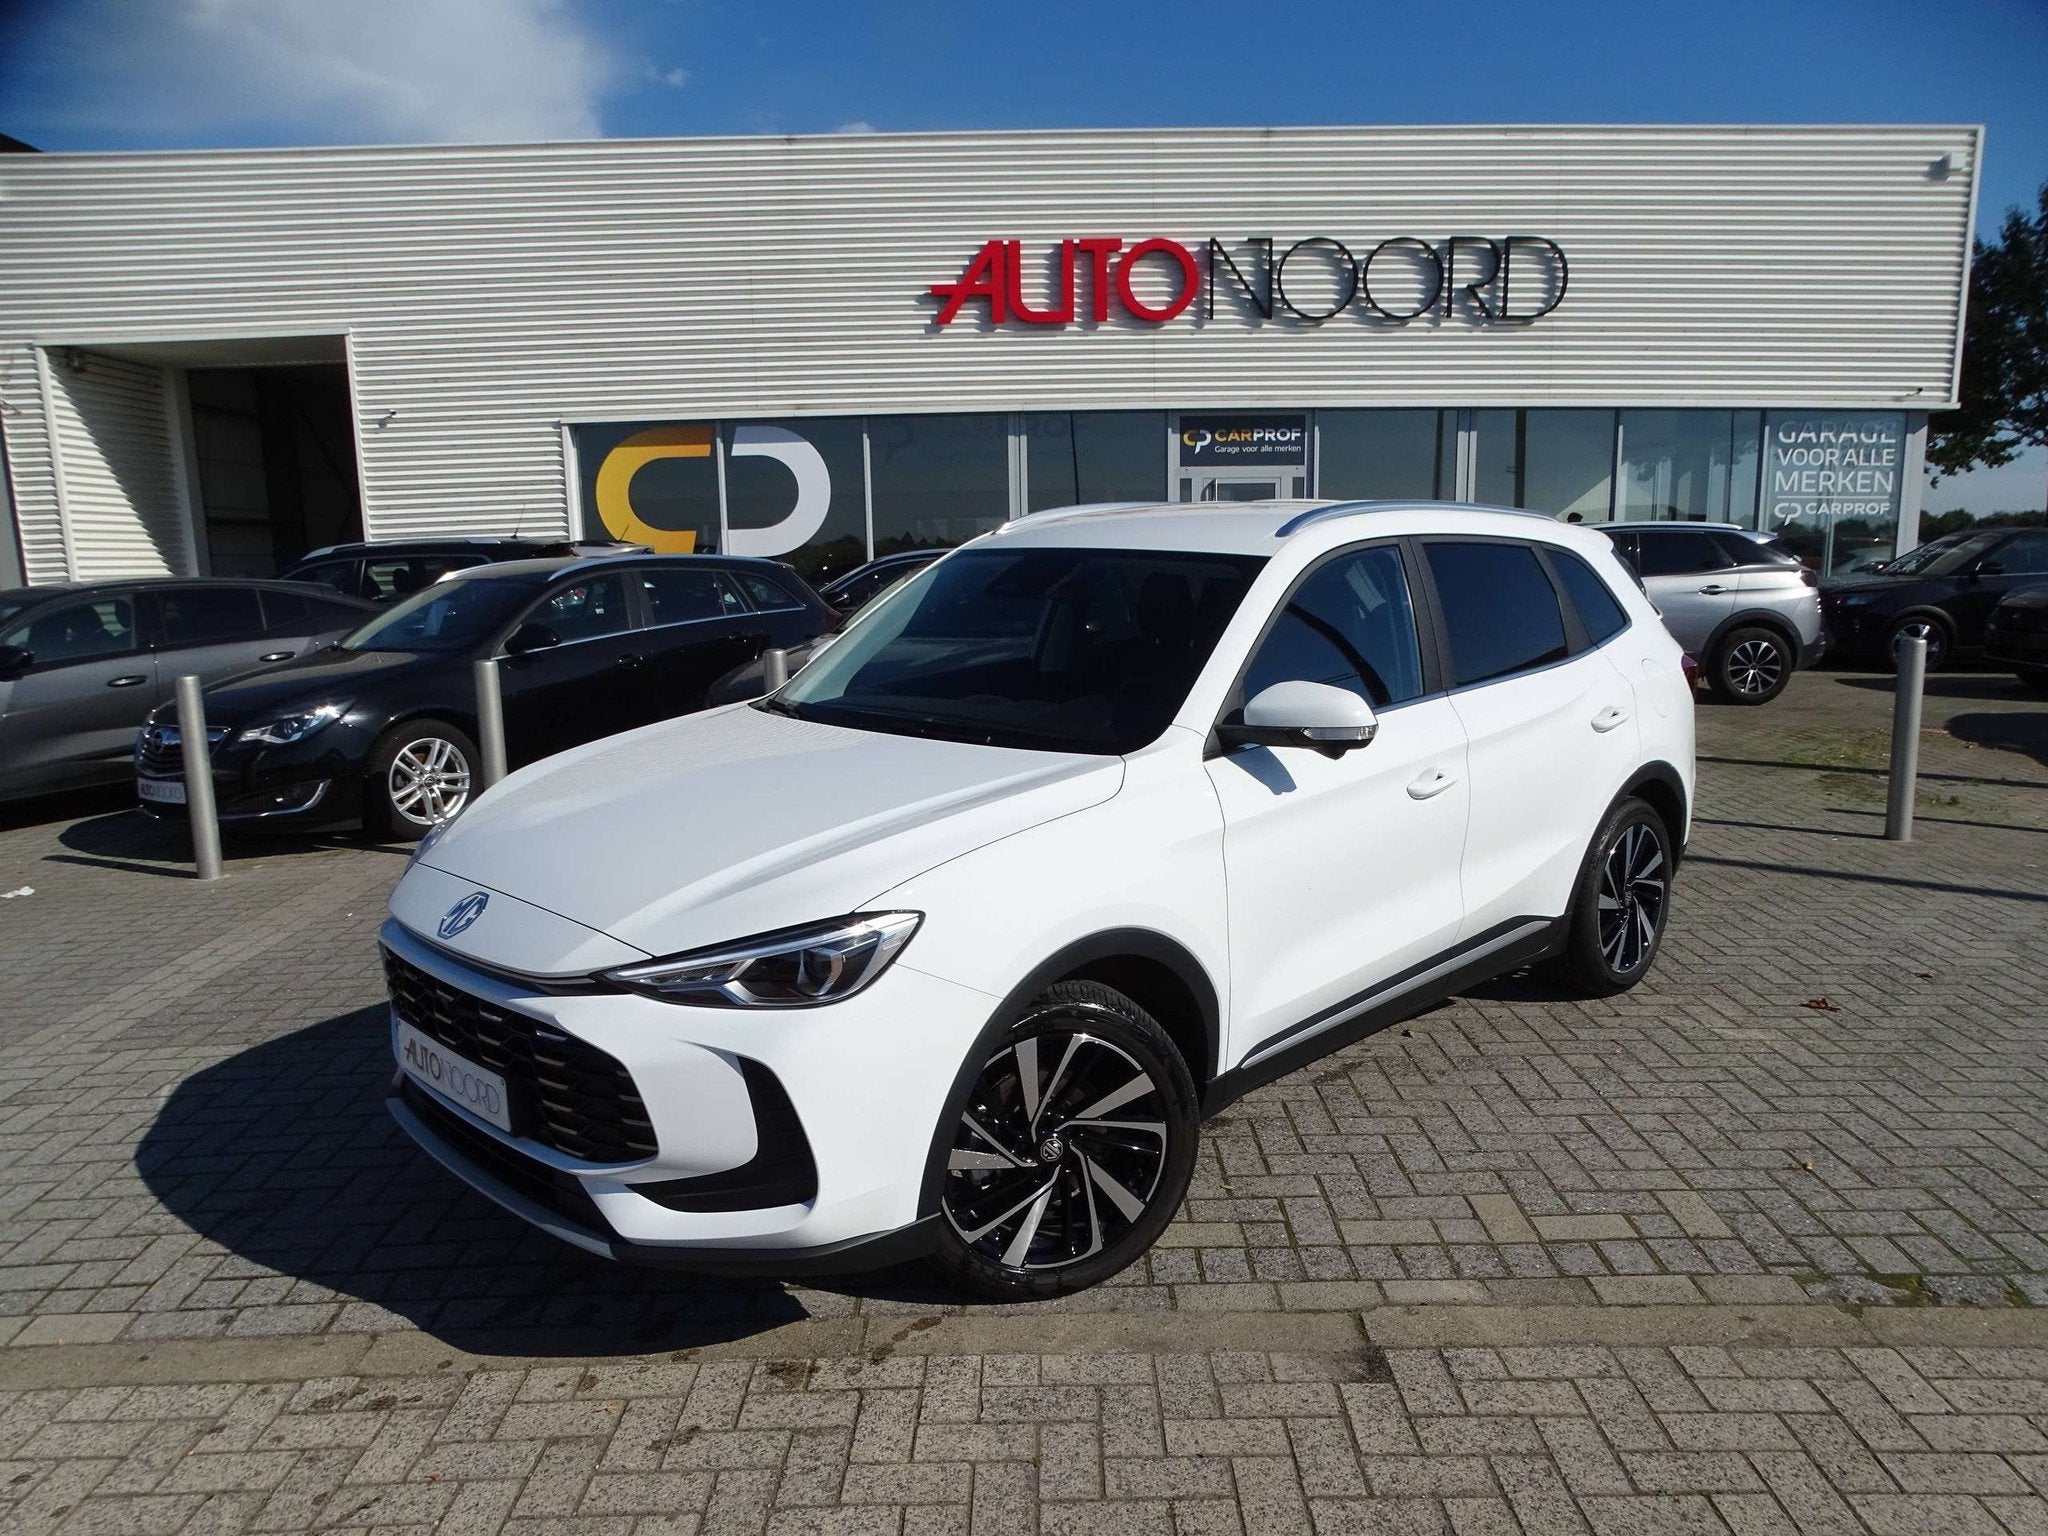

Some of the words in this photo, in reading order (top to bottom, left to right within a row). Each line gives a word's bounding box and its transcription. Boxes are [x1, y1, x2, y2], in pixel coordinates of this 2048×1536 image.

[1214, 428, 1301, 442] CARPROF
[1778, 421, 1896, 443] GARAGE
[1214, 445, 1240, 454] Garage
[1260, 444, 1273, 453] alle
[1274, 444, 1302, 453] merken
[1777, 448, 1839, 466] VOOR
[1842, 448, 1896, 466] ALLE
[1774, 470, 1894, 493] MERKEN
[1805, 502, 1891, 515] CARPROF
[439, 893, 488, 938] MG
